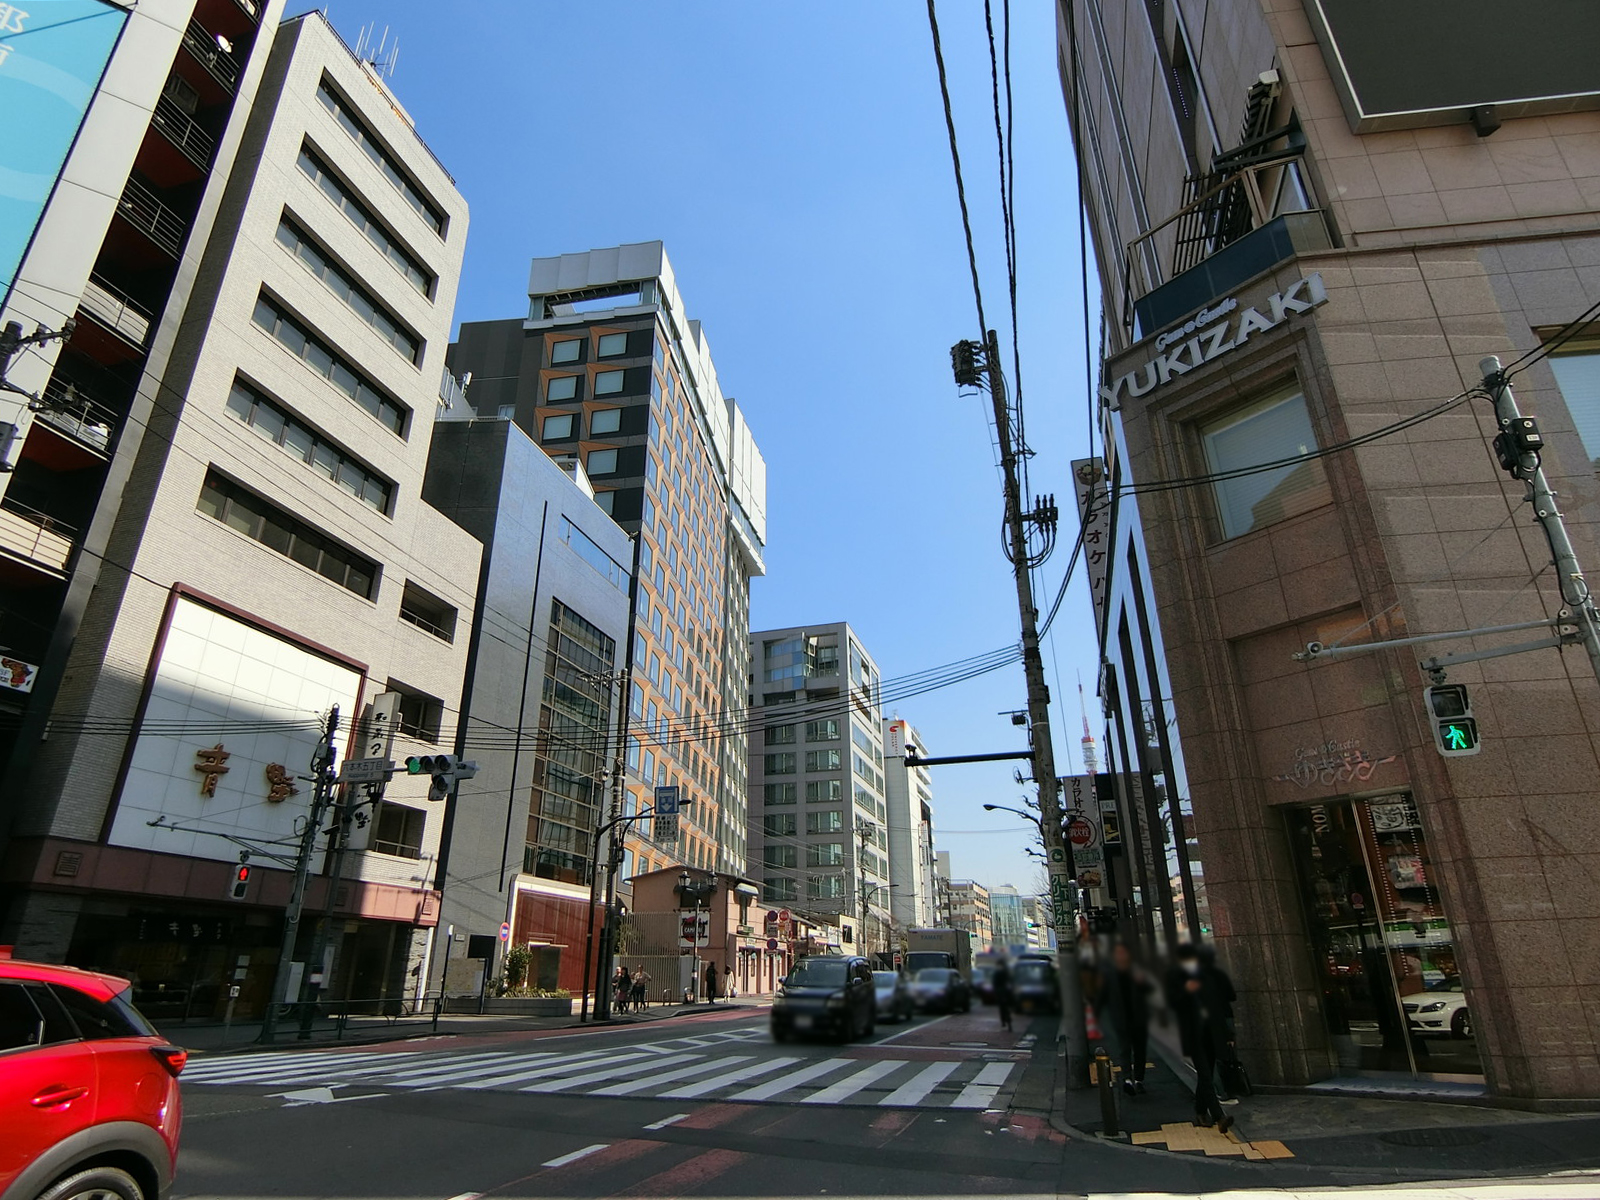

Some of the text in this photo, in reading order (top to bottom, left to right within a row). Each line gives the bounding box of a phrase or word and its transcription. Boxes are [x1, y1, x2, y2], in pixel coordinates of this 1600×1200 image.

[1195, 296, 1238, 327] Castle
[1098, 272, 1330, 412] YUKIZAKI
[1051, 874, 1064, 926] クリニック
